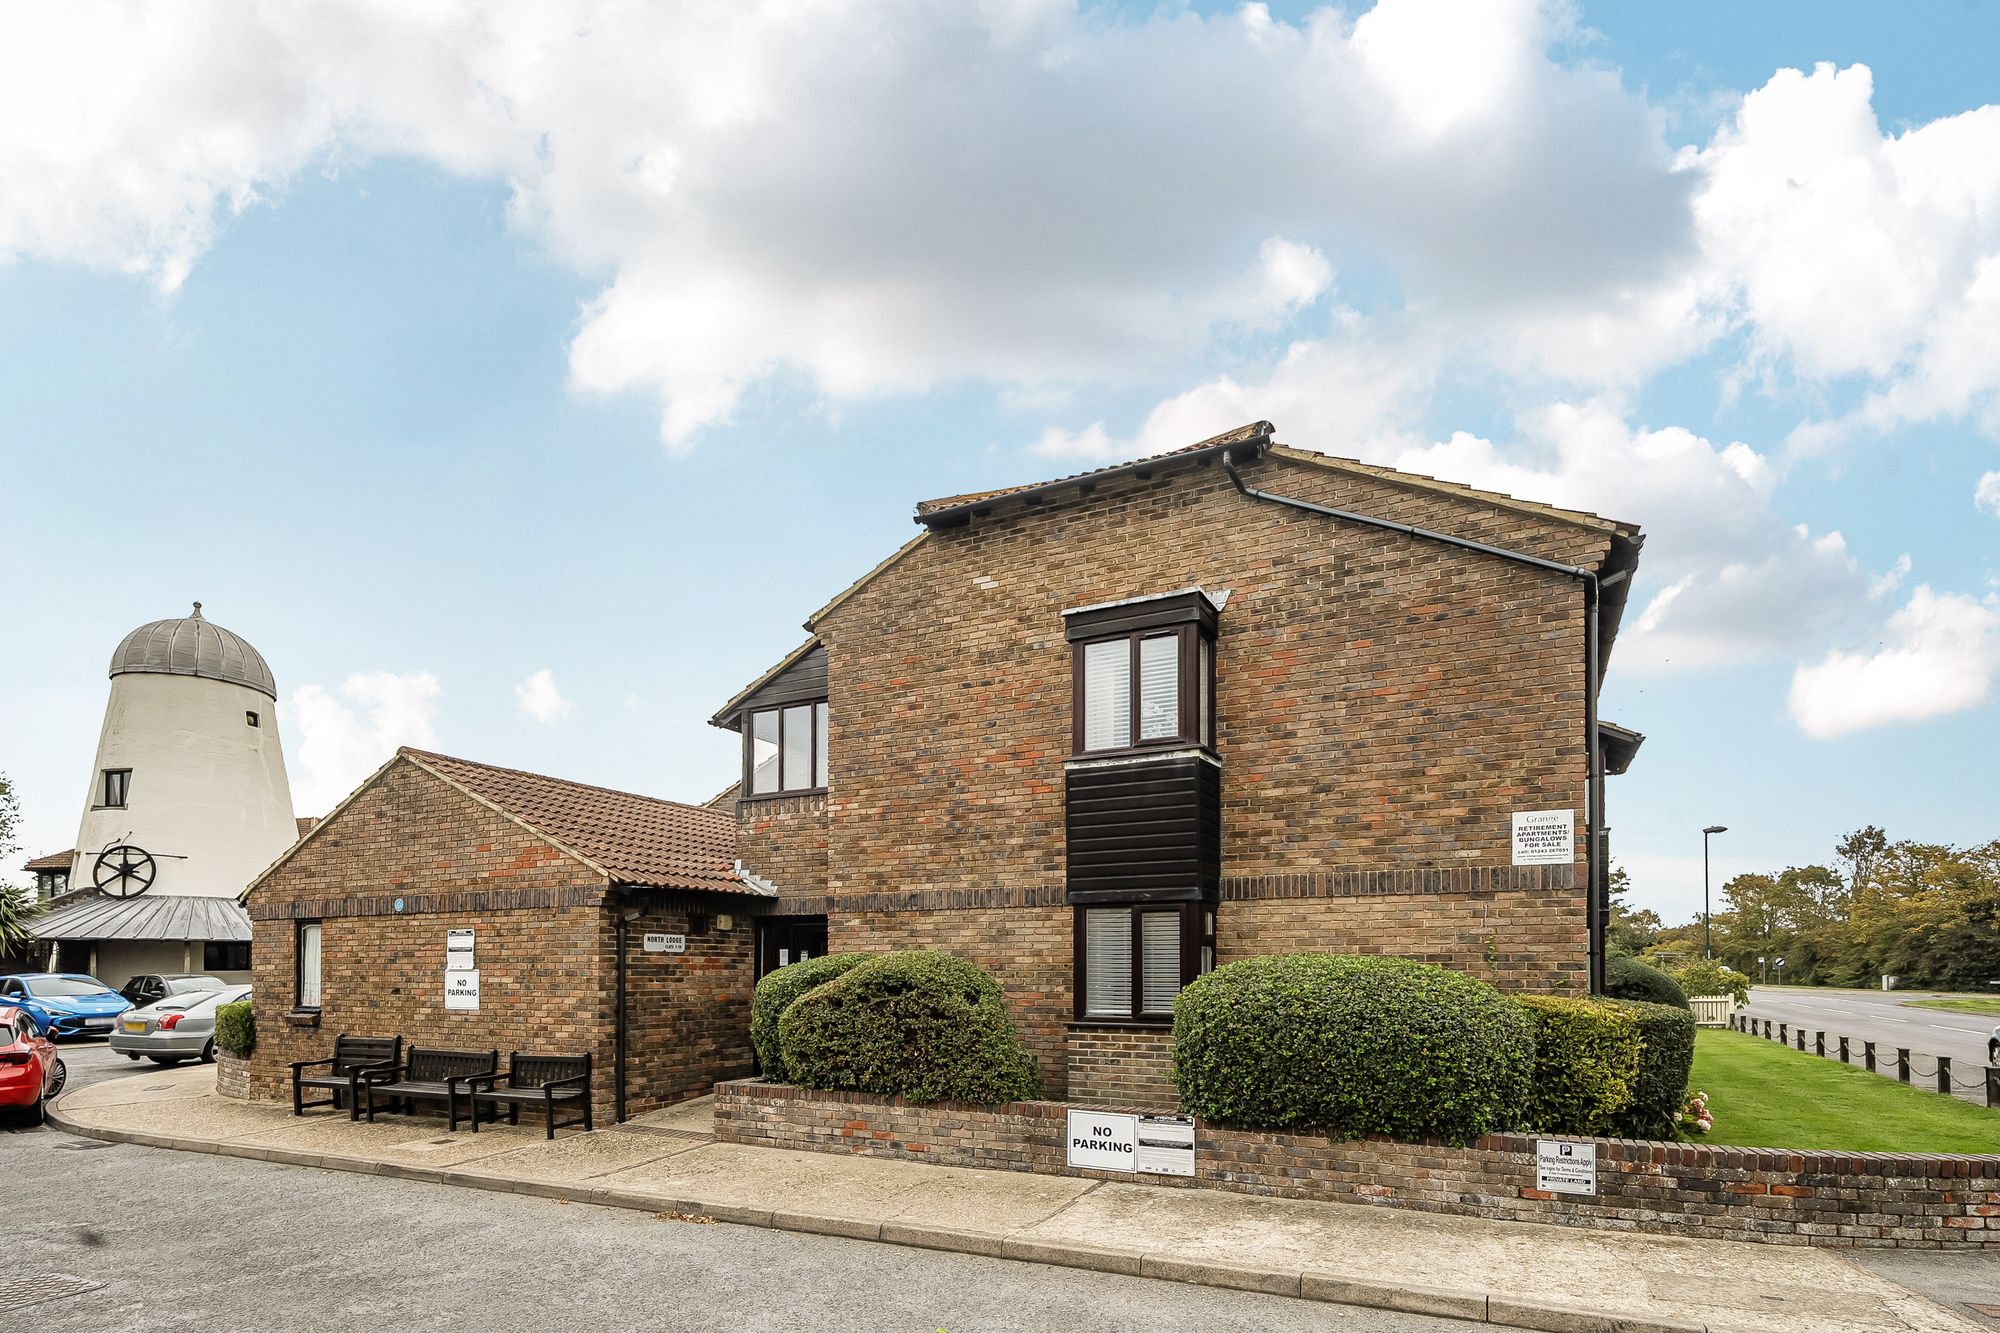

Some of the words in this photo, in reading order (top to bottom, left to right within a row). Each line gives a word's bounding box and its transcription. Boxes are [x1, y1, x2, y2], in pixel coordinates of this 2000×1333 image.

[456, 979, 467, 987] NO
[447, 988, 477, 997] PARKING
[1093, 1126, 1112, 1137] NO
[1073, 1138, 1133, 1154] PARKING
[1540, 1154, 1555, 1165] Parking
[1555, 1156, 1580, 1165] Restrictions
[1580, 1158, 1592, 1168] Apply
